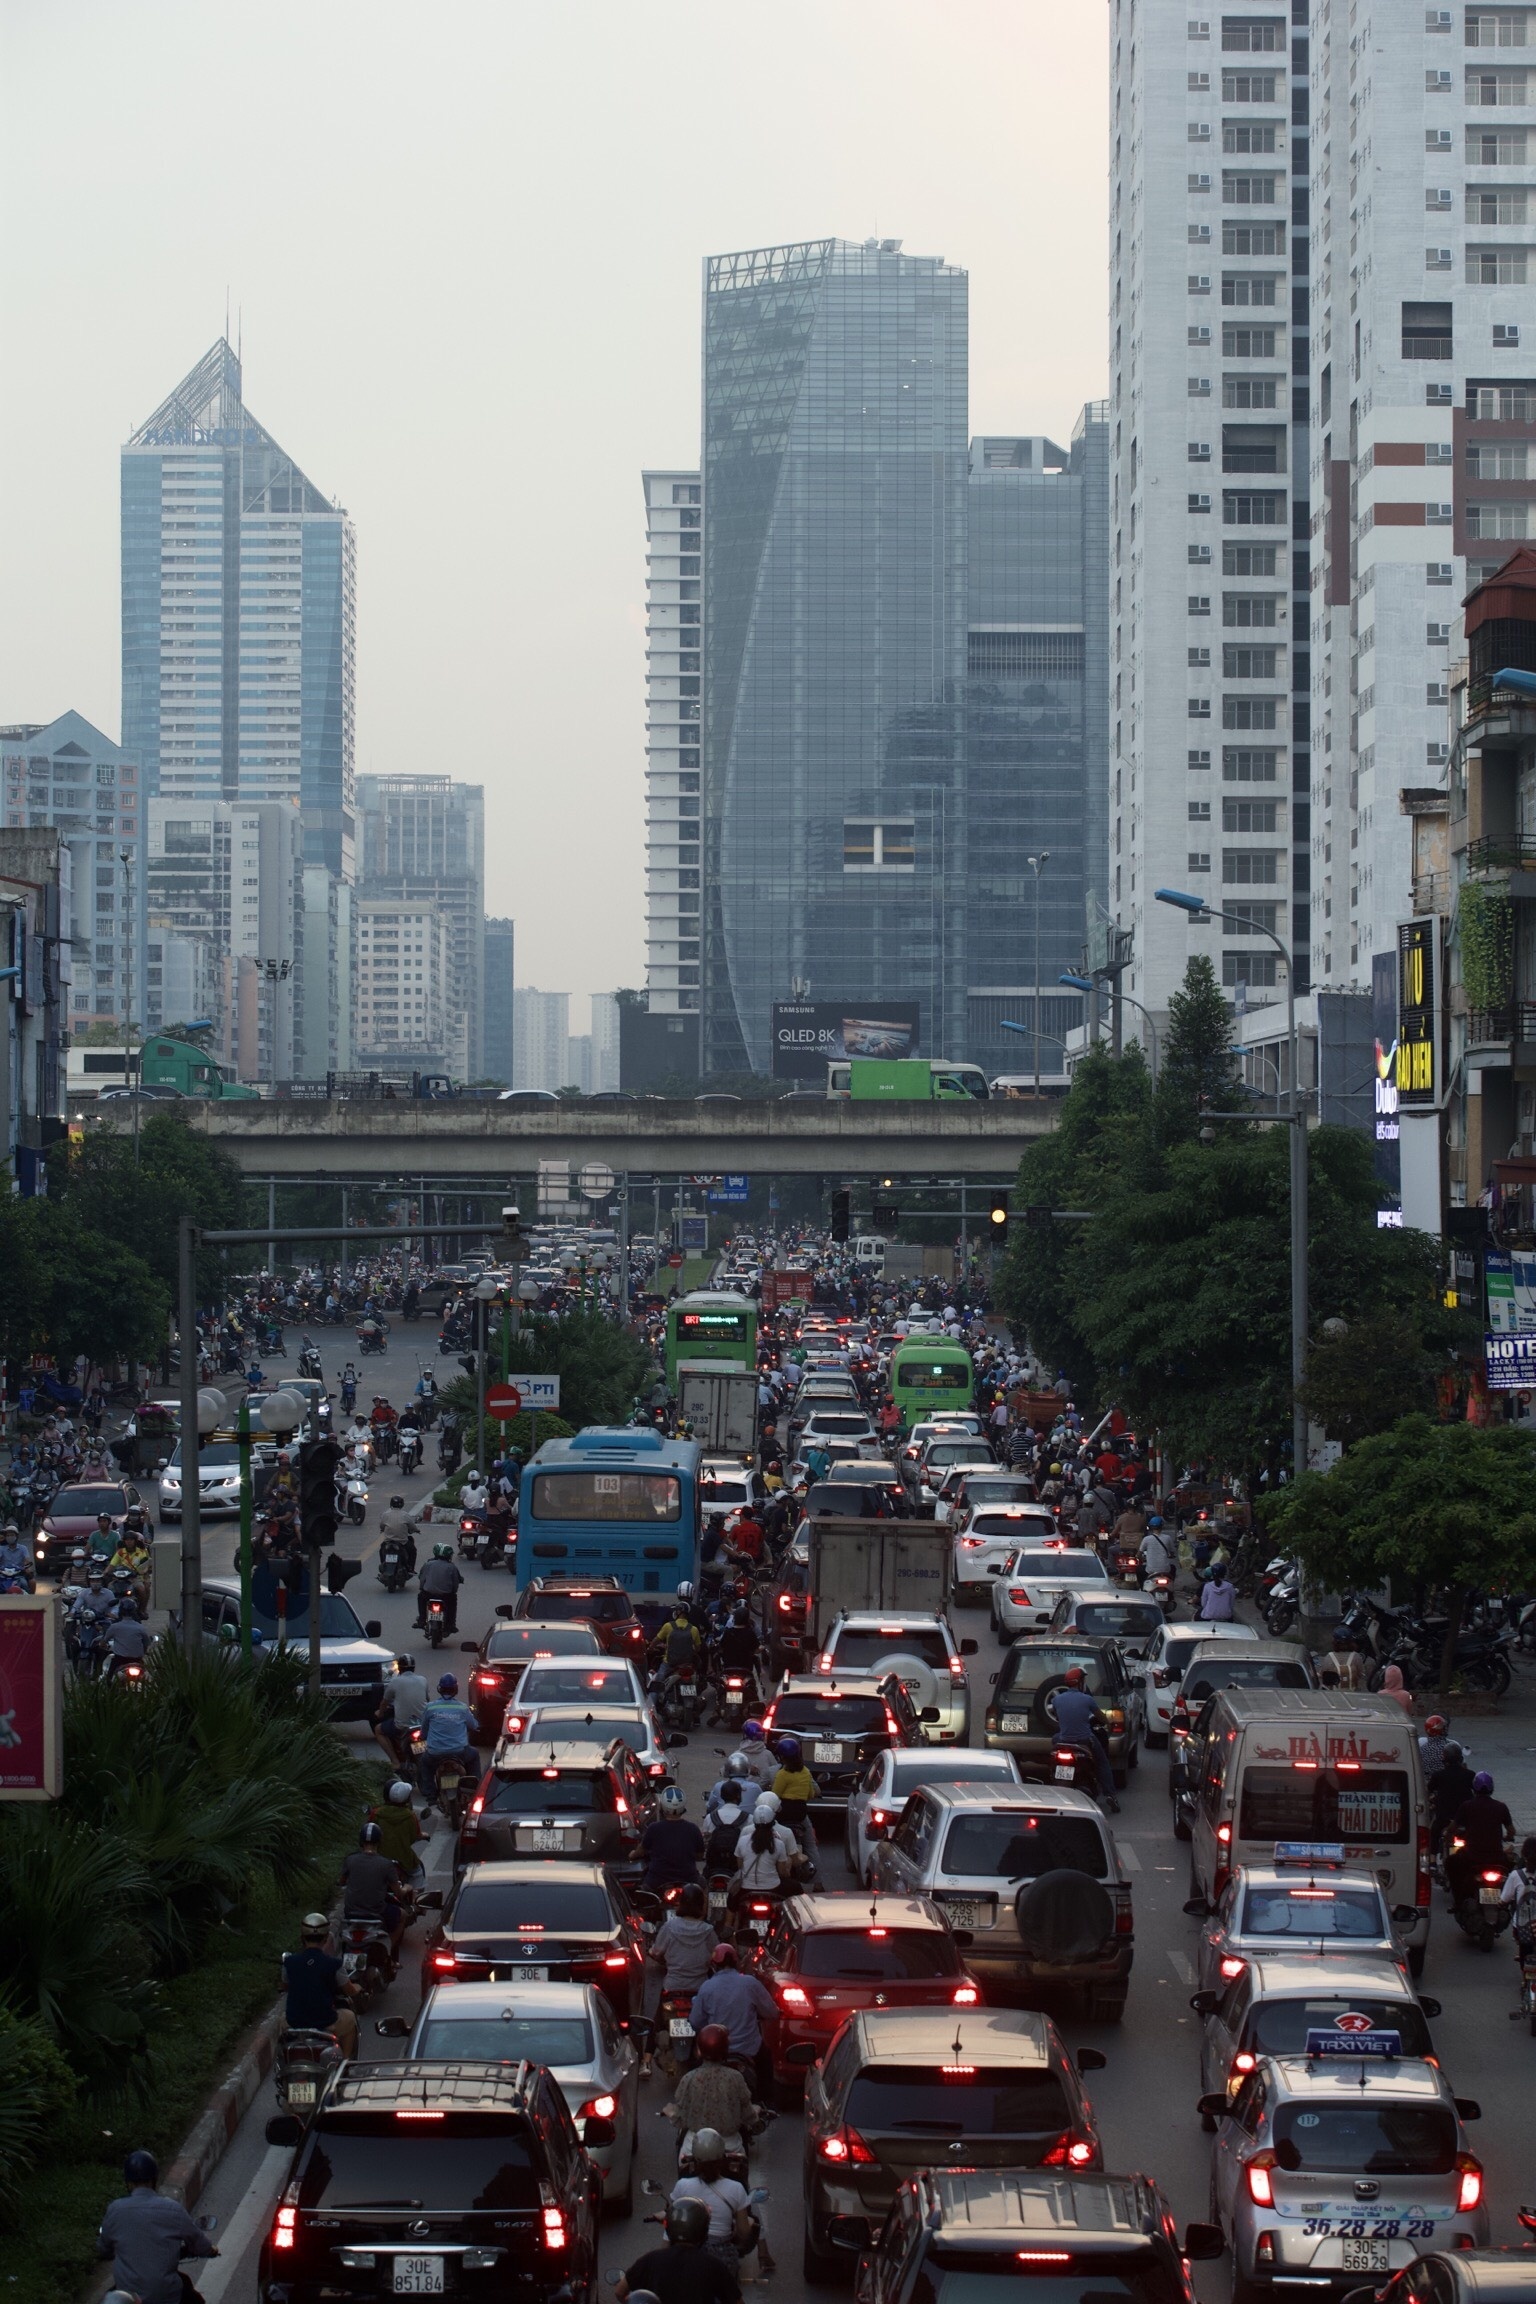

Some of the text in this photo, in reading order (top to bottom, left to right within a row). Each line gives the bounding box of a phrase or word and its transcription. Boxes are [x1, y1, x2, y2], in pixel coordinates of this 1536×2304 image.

[778, 1029, 836, 1043] QLED 8K
[533, 1384, 554, 1395] PTI
[691, 1403, 704, 1411] 29C
[685, 1415, 709, 1424] 370.33
[596, 1477, 618, 1491] 103
[821, 1744, 836, 1753] 30E
[1288, 1730, 1369, 1760] HÀ HẢI
[815, 1753, 842, 1762] 640.75
[1338, 1791, 1377, 1804] THÀNH
[1338, 1805, 1401, 1832] THÁI BÌNH
[540, 1830, 556, 1840] 29A
[534, 1840, 563, 1851] 624.07
[1301, 1844, 1322, 1856] SÔNG
[952, 1904, 973, 1915] 29S
[950, 1915, 974, 1926] 7125
[520, 1968, 540, 1980] 30E
[1318, 2040, 1355, 2050] TAXI
[1301, 2116, 1316, 2124] 117
[1354, 2240, 1379, 2254] 30E
[406, 2259, 432, 2274] 30E
[1344, 2255, 1388, 2270] 569.29
[395, 2276, 442, 2292] 851.84
